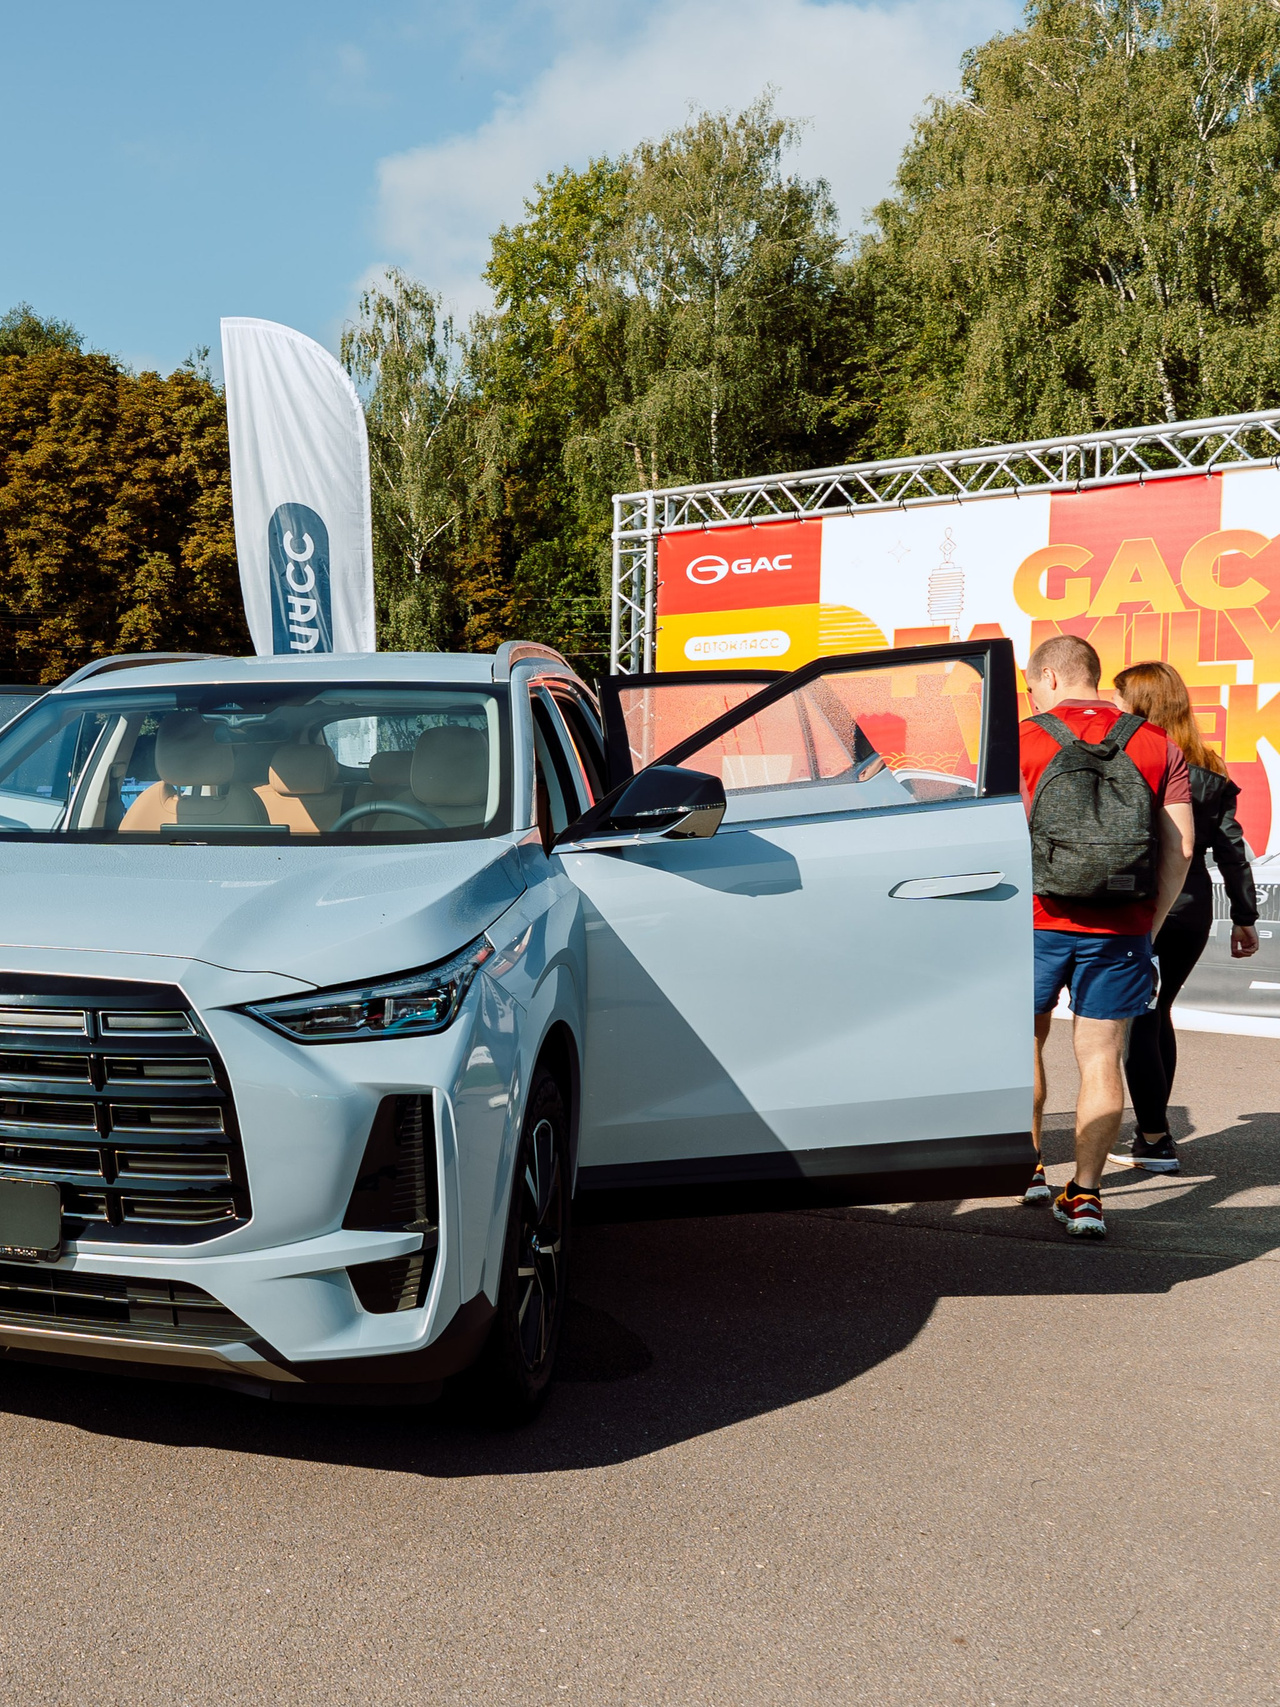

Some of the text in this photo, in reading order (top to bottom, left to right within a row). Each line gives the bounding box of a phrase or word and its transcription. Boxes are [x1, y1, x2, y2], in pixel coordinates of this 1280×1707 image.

[731, 554, 793, 575] GAC
[1013, 529, 1272, 621] GAC
[694, 637, 780, 654] АВТОКЛАСС
